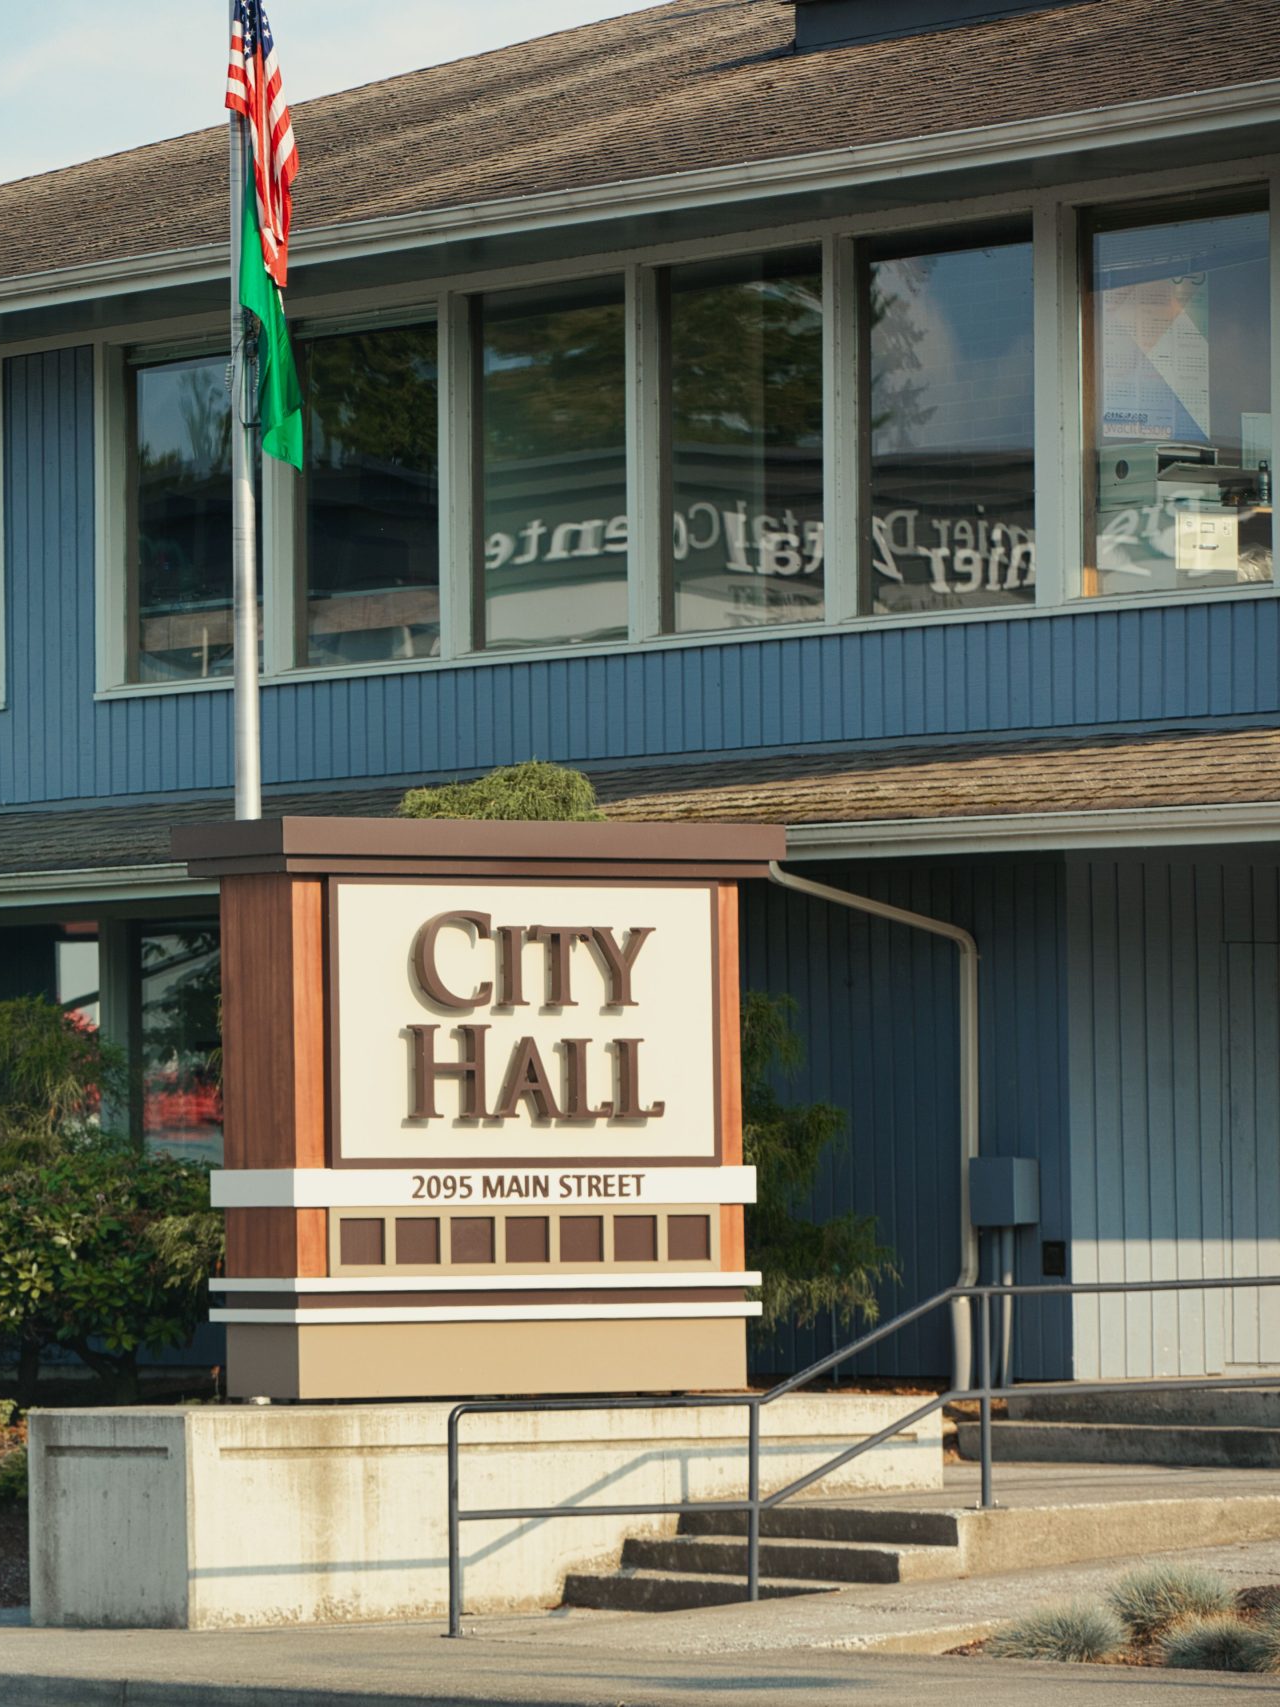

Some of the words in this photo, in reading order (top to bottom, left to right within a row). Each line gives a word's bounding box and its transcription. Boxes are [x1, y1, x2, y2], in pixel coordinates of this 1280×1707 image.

[411, 1175, 473, 1199] 2095
[482, 1174, 549, 1198] MAIN
[559, 1173, 646, 1198] STREET
